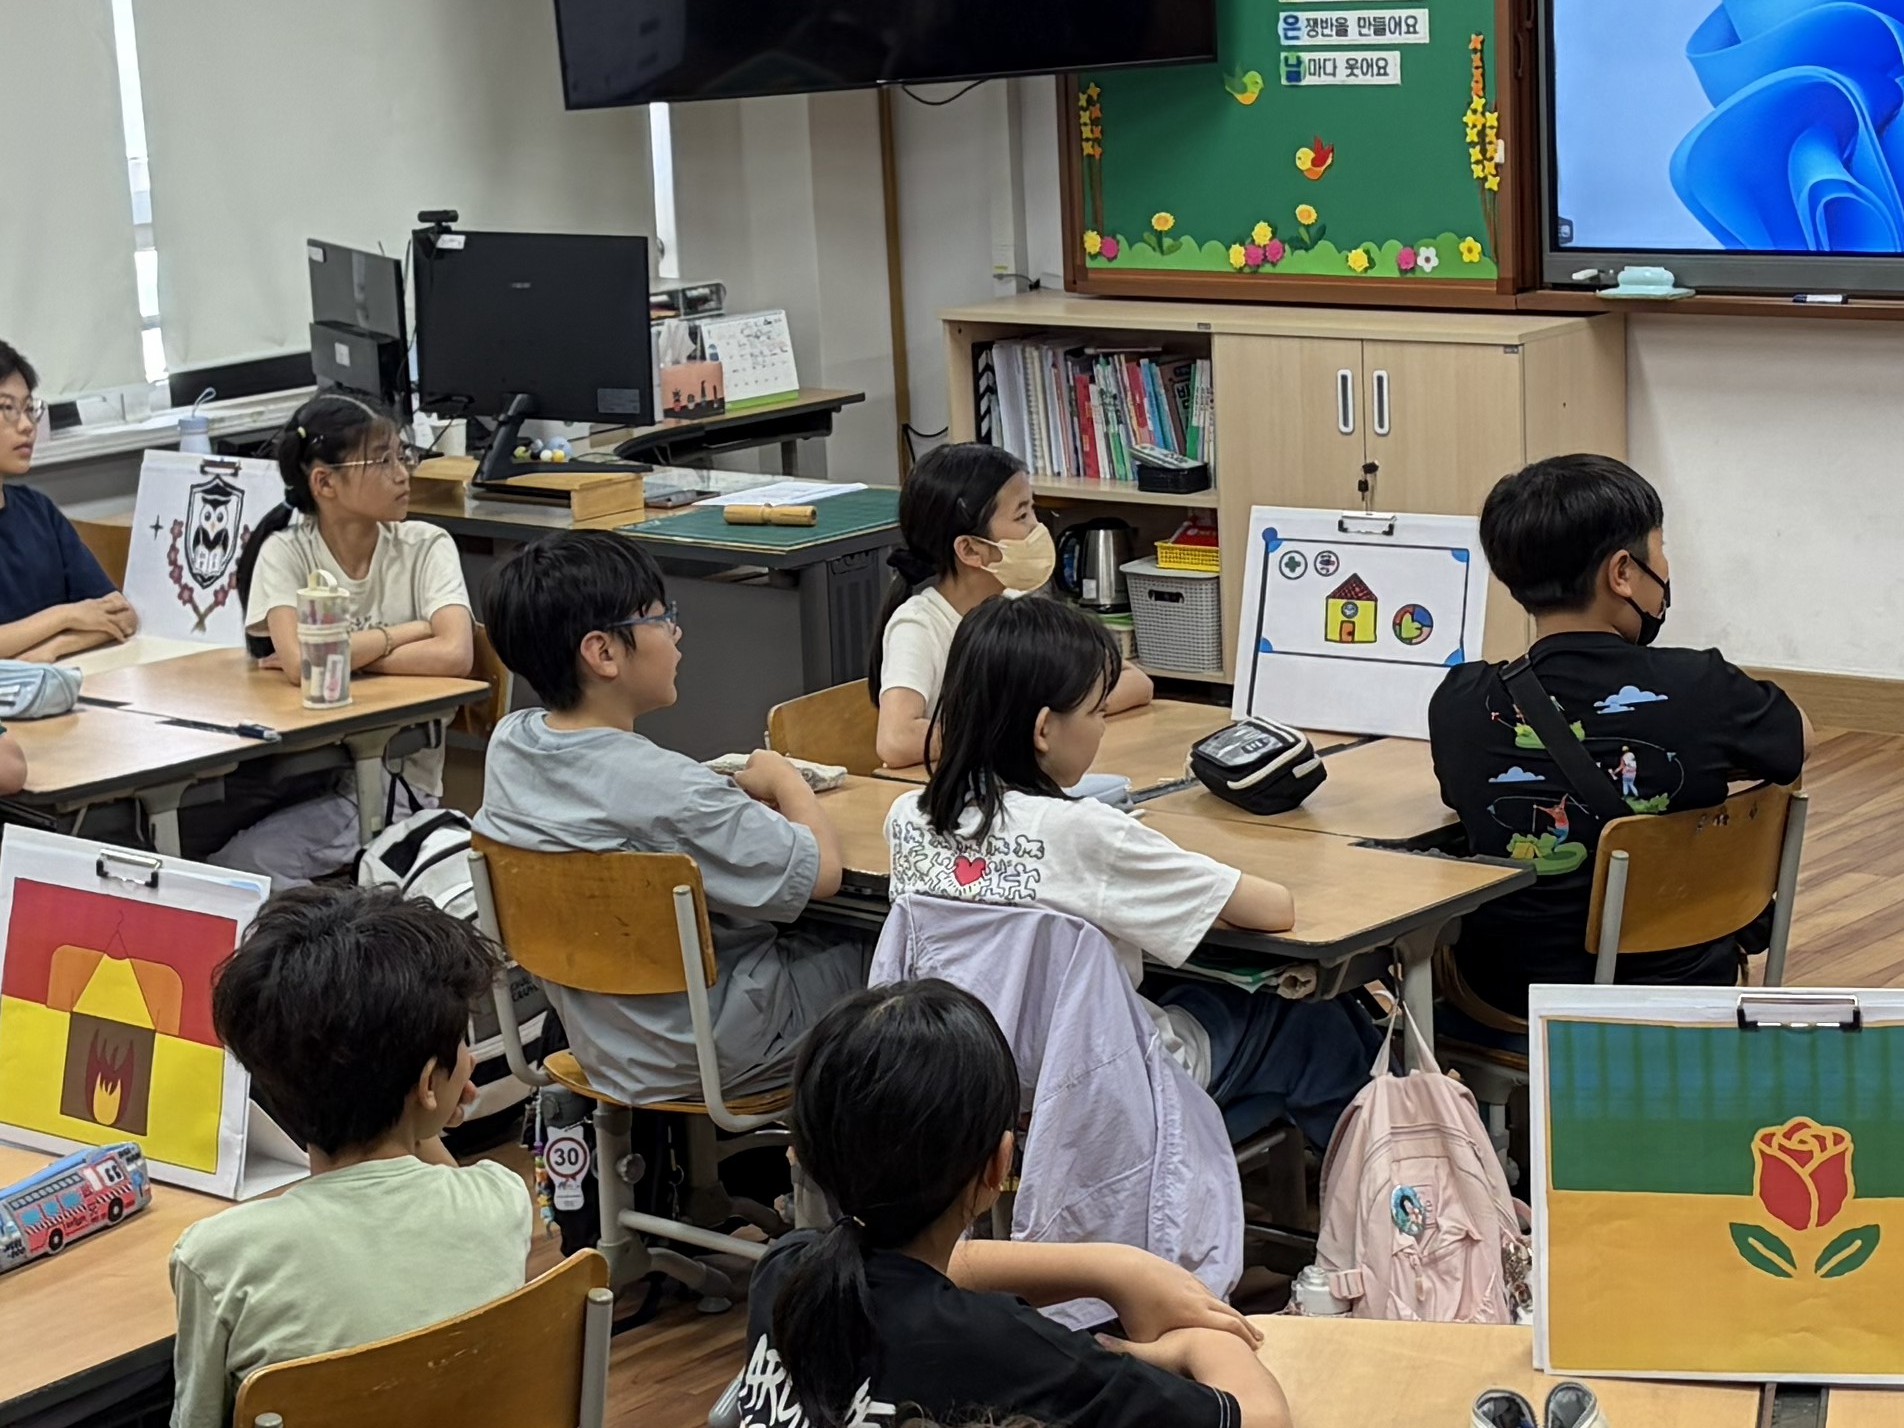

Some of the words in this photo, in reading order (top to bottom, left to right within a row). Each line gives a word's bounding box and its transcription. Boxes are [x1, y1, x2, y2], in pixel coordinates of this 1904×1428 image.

[1357, 13, 1420, 38] 만들어요
[1344, 56, 1390, 80] 웃어요
[553, 1148, 579, 1167] 30
